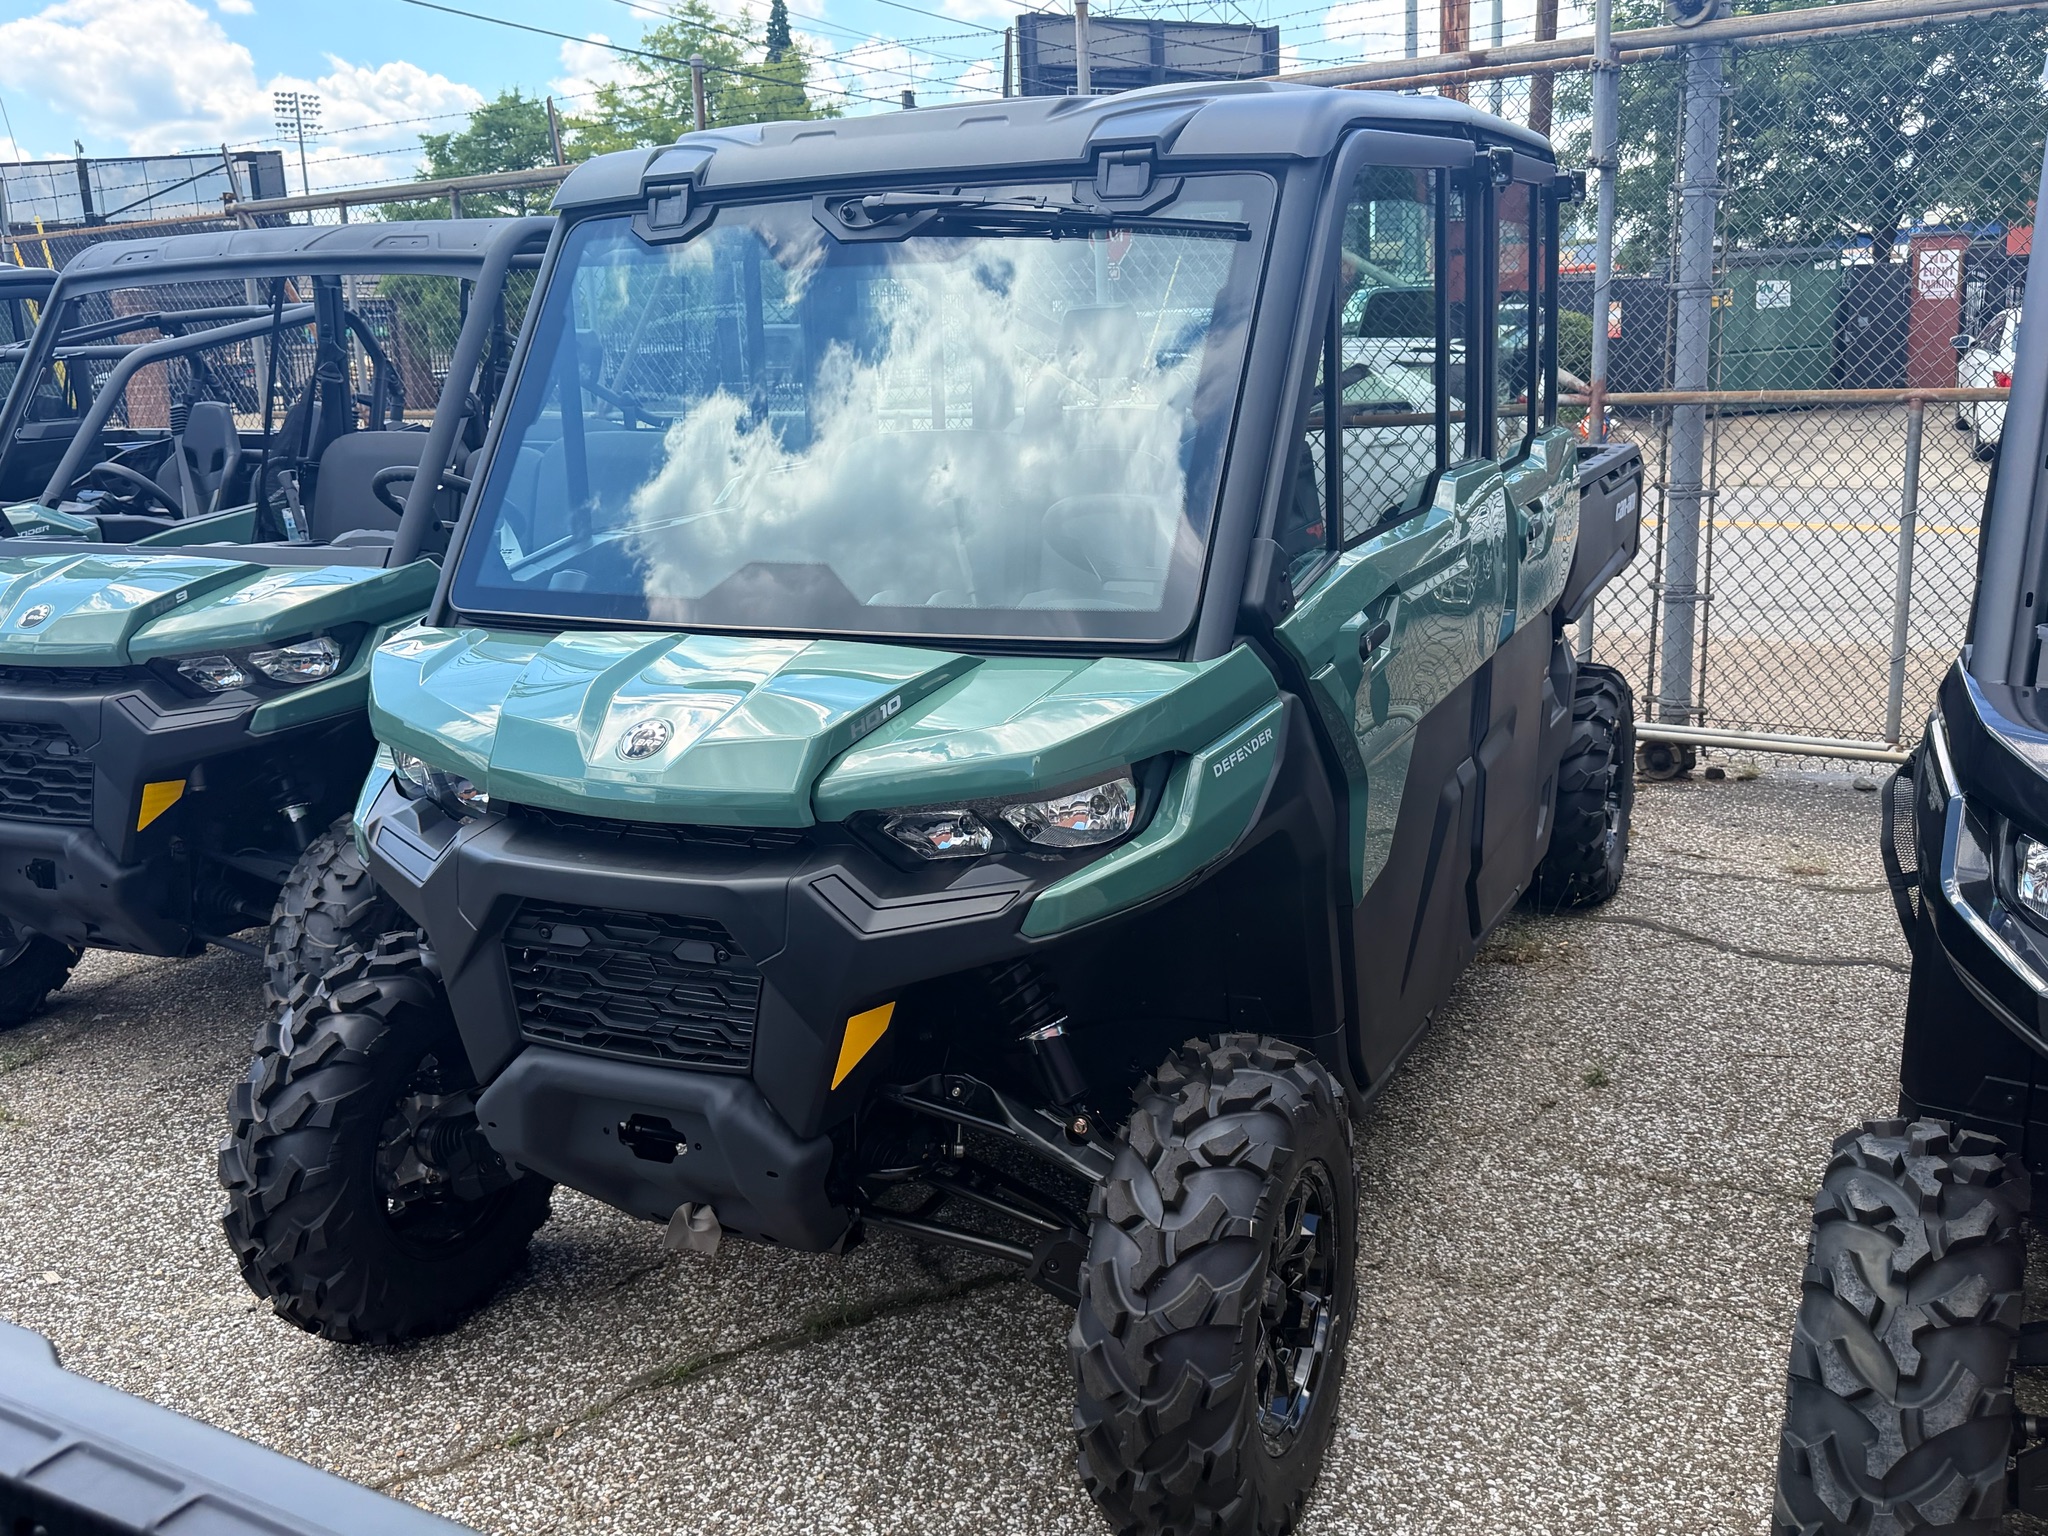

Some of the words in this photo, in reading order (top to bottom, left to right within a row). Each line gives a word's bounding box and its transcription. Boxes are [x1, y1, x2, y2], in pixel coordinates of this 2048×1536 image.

[850, 694, 902, 740] HD10
[635, 738, 661, 747] BRP
[1212, 727, 1274, 778] DEFENDER
